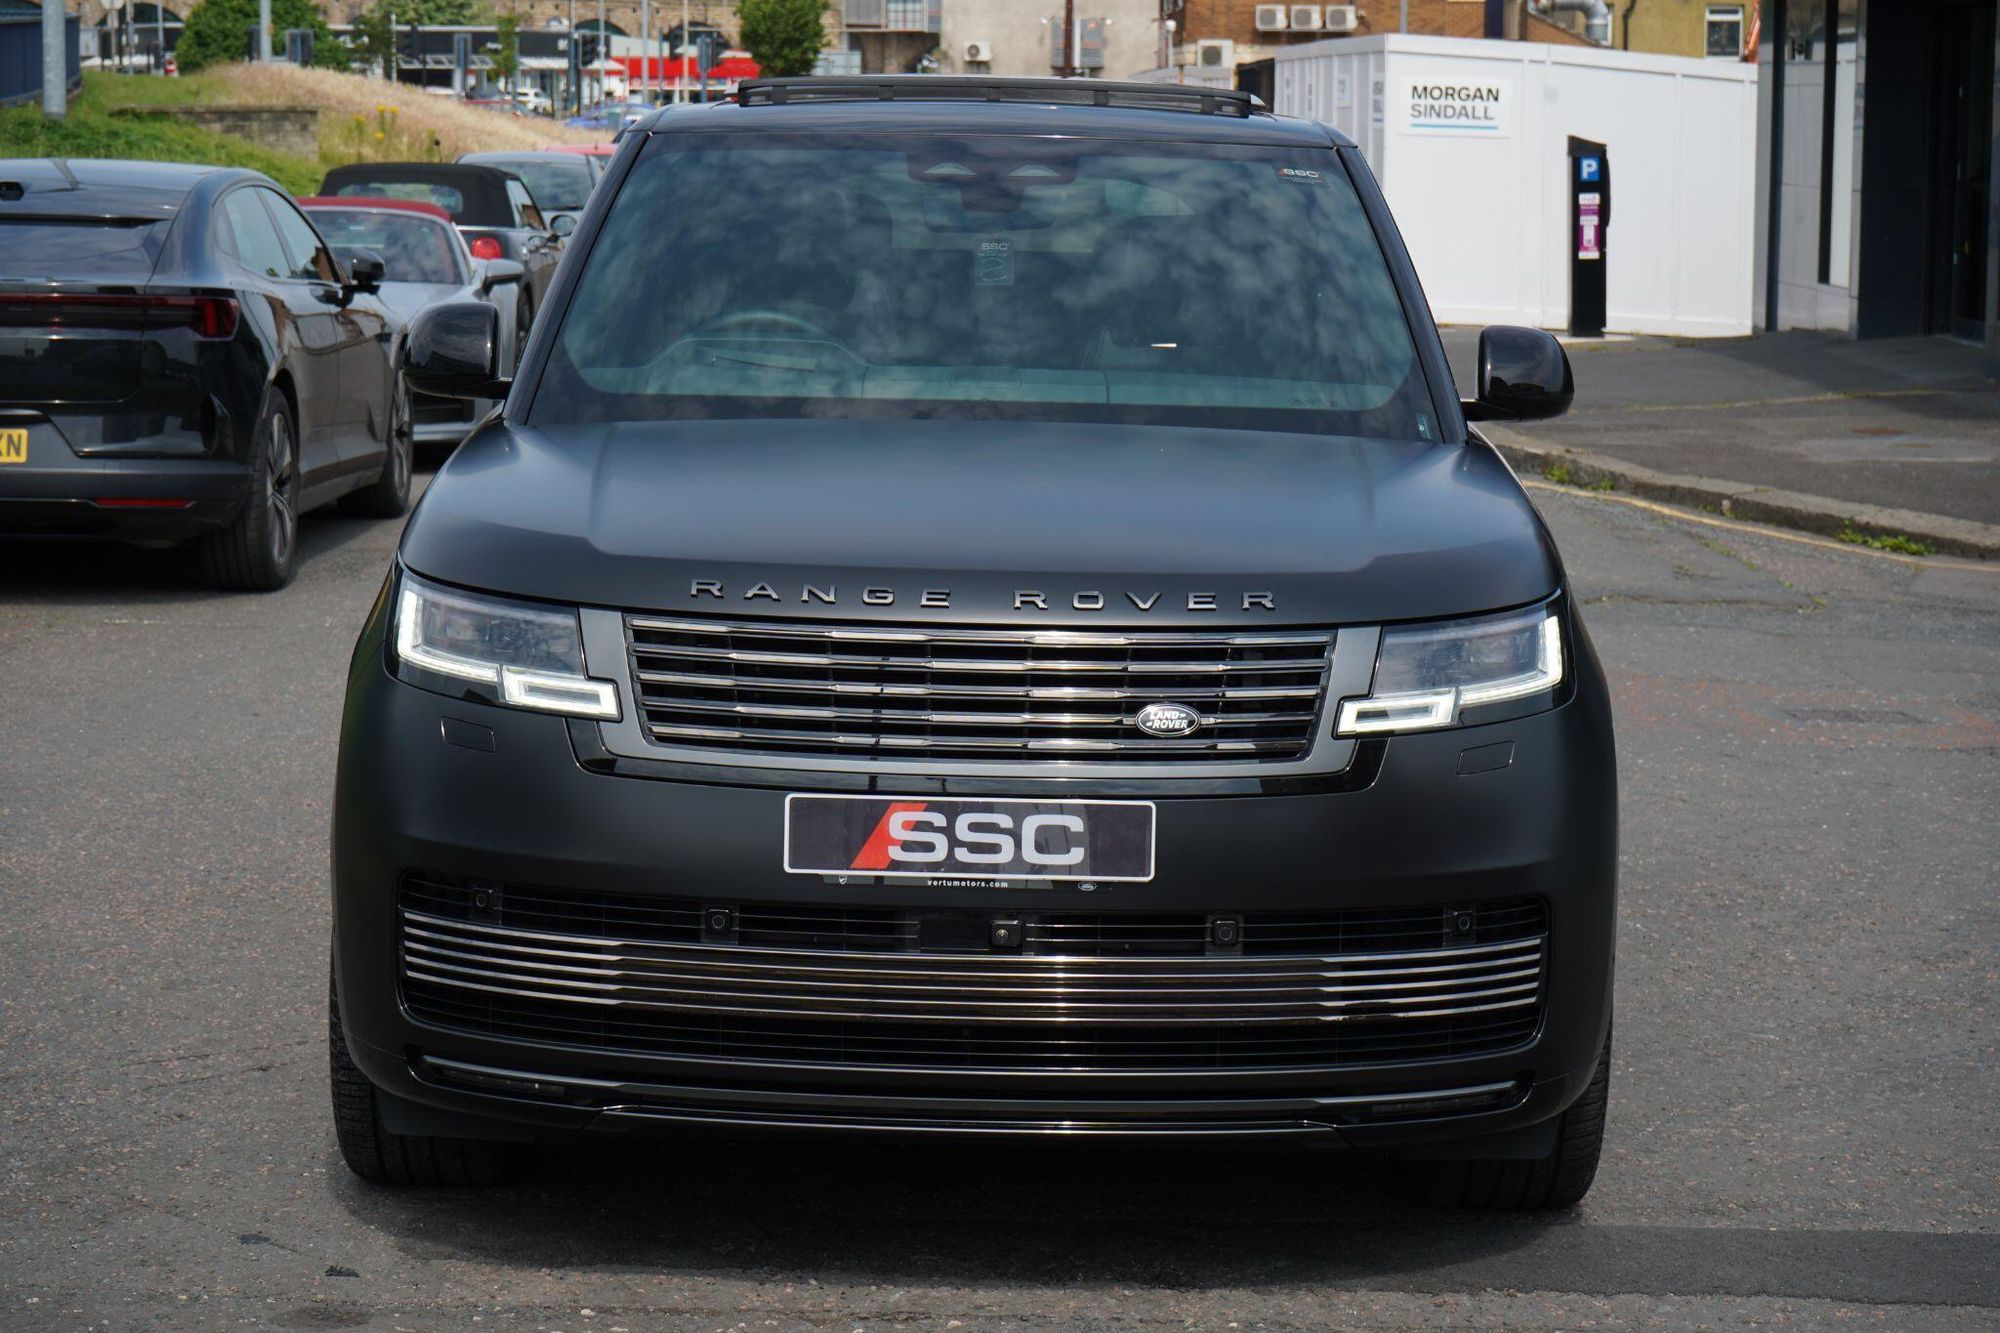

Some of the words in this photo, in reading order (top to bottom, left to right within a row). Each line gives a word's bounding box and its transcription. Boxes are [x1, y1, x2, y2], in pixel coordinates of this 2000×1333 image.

[1411, 85, 1500, 103] MORGAN
[1410, 103, 1495, 121] SINDALL
[1582, 159, 1597, 179] P
[689, 577, 951, 609] RANGE
[1013, 588, 1276, 612] ROVER
[1149, 710, 1180, 720] LAND
[1152, 719, 1188, 729] ROVER
[887, 811, 1085, 865] SSC
[926, 879, 1009, 888] vertumotors.com
